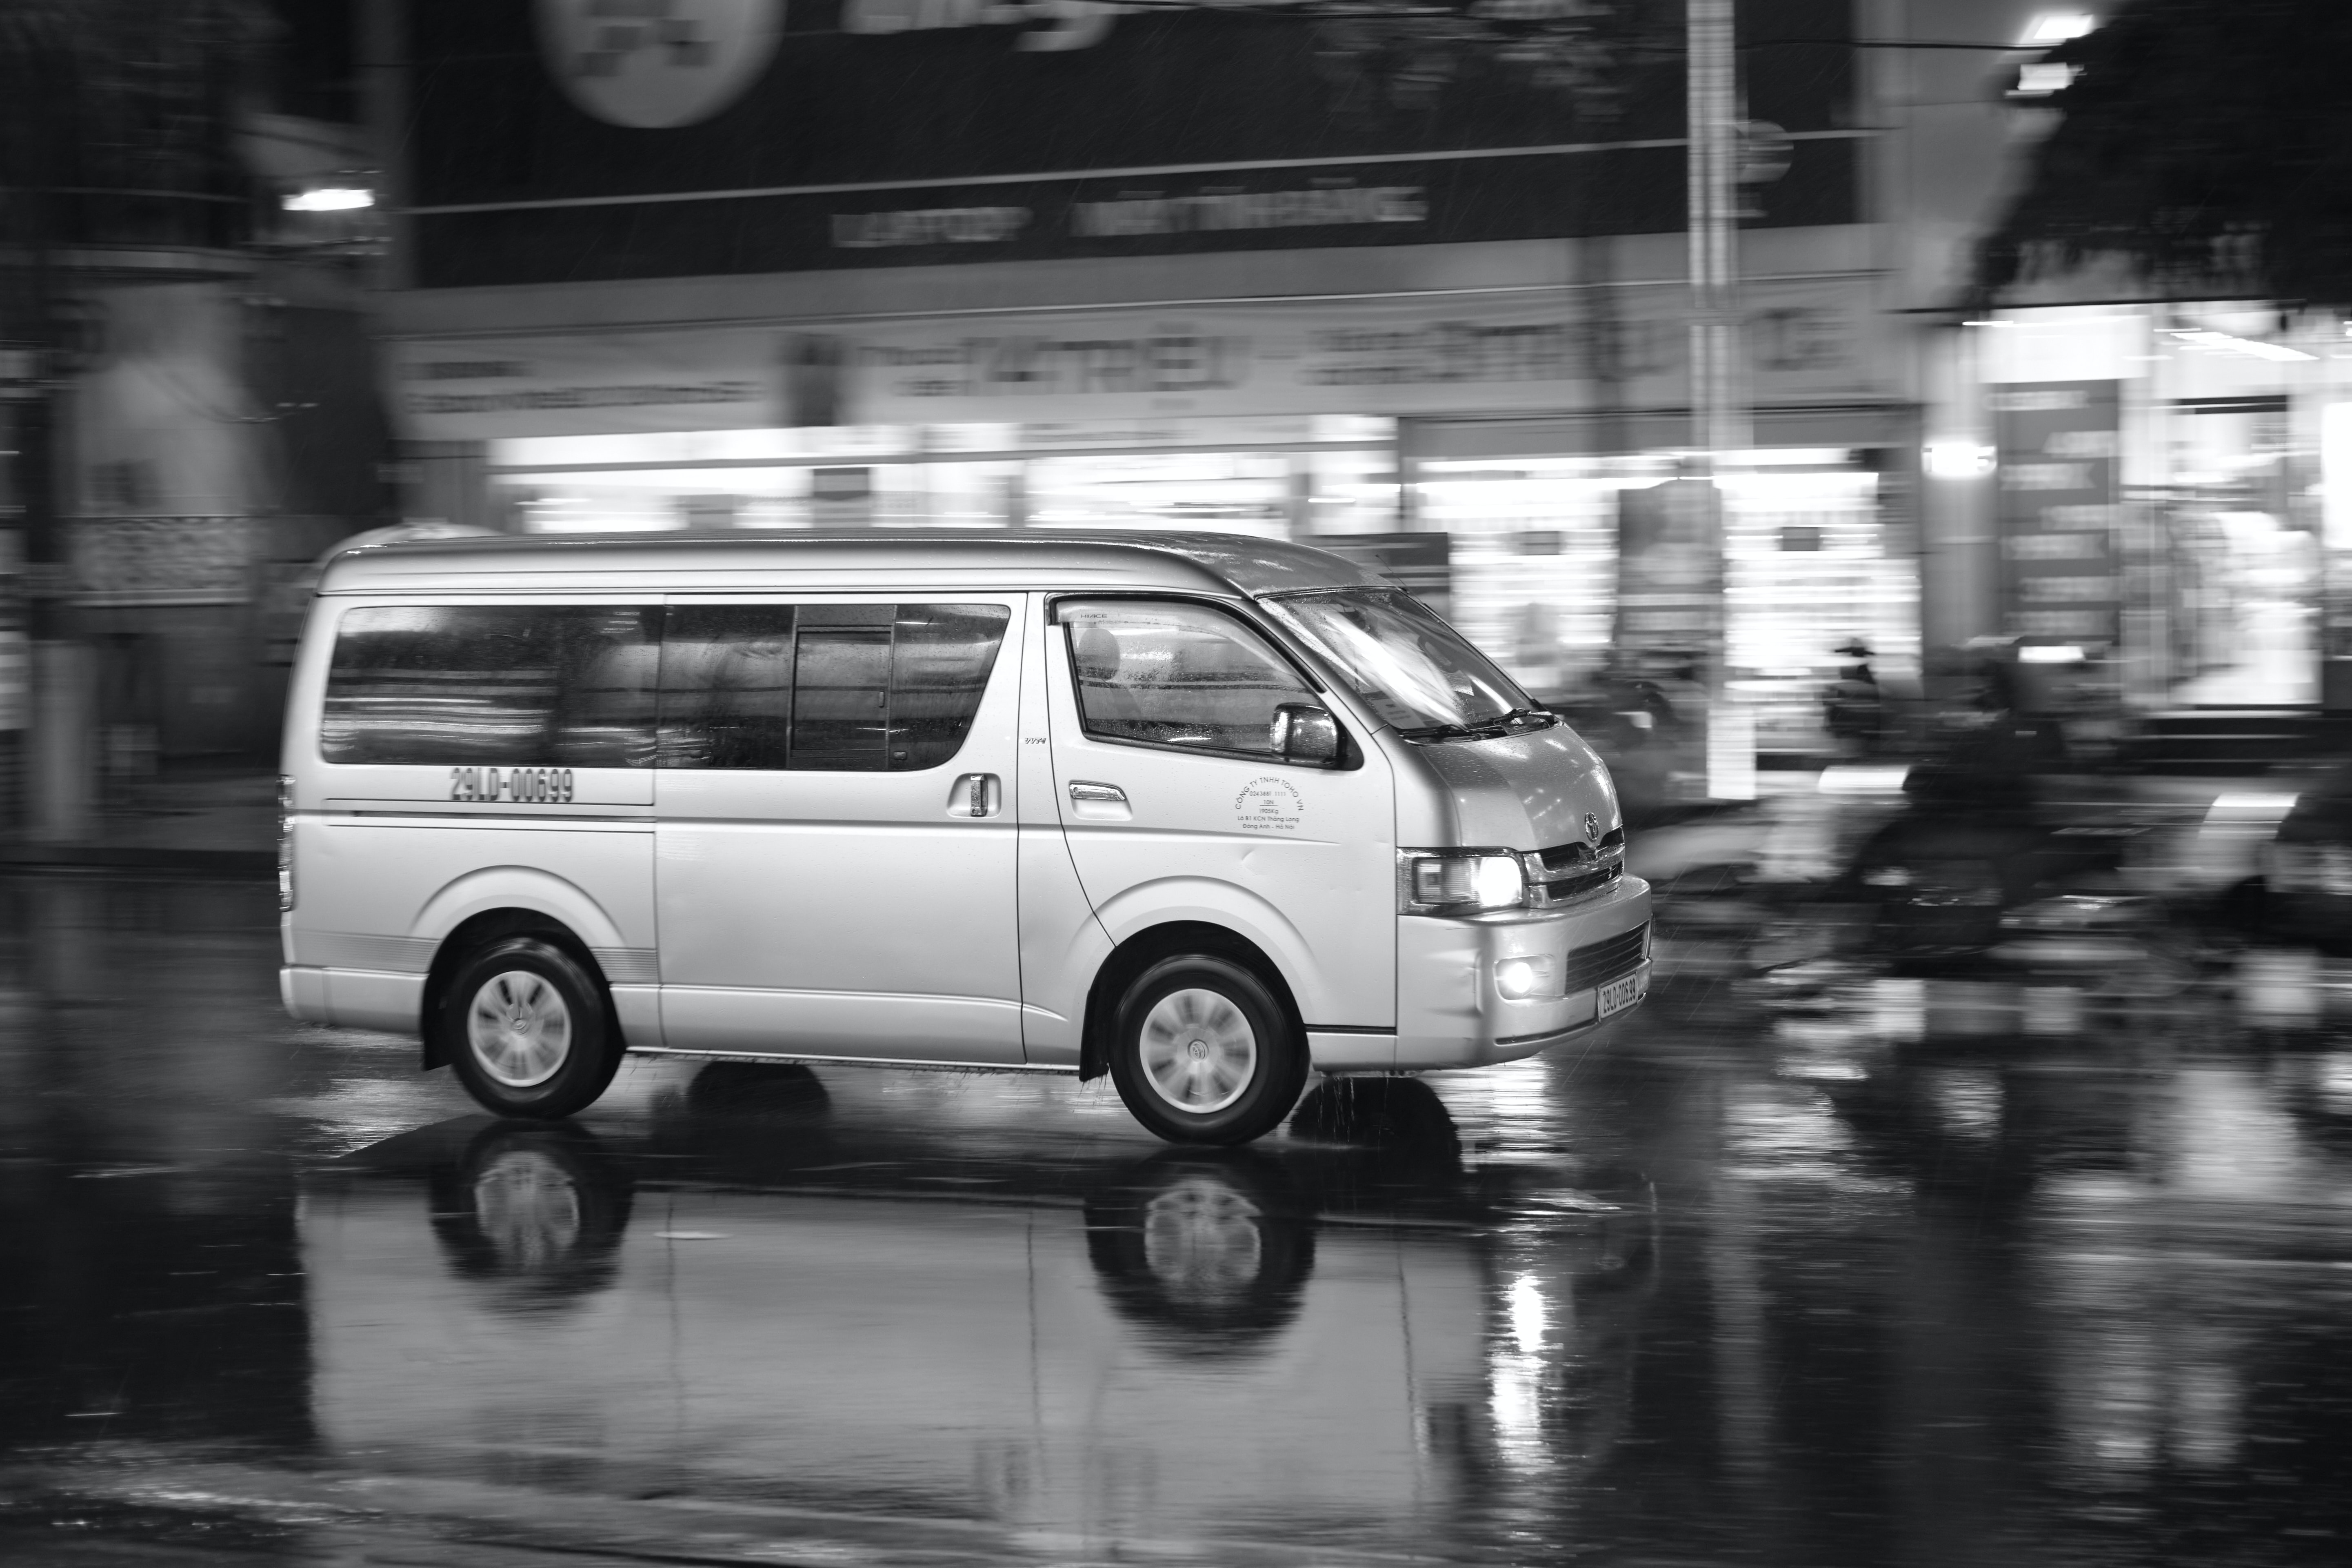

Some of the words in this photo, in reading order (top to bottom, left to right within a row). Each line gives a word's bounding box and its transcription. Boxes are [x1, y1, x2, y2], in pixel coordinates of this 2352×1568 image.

[450, 767, 573, 802] 29LD-00699
[1235, 786, 1250, 810] CÔNG
[1250, 779, 1258, 787] TY
[1281, 780, 1299, 797] TOHO
[1296, 799, 1304, 811] VN
